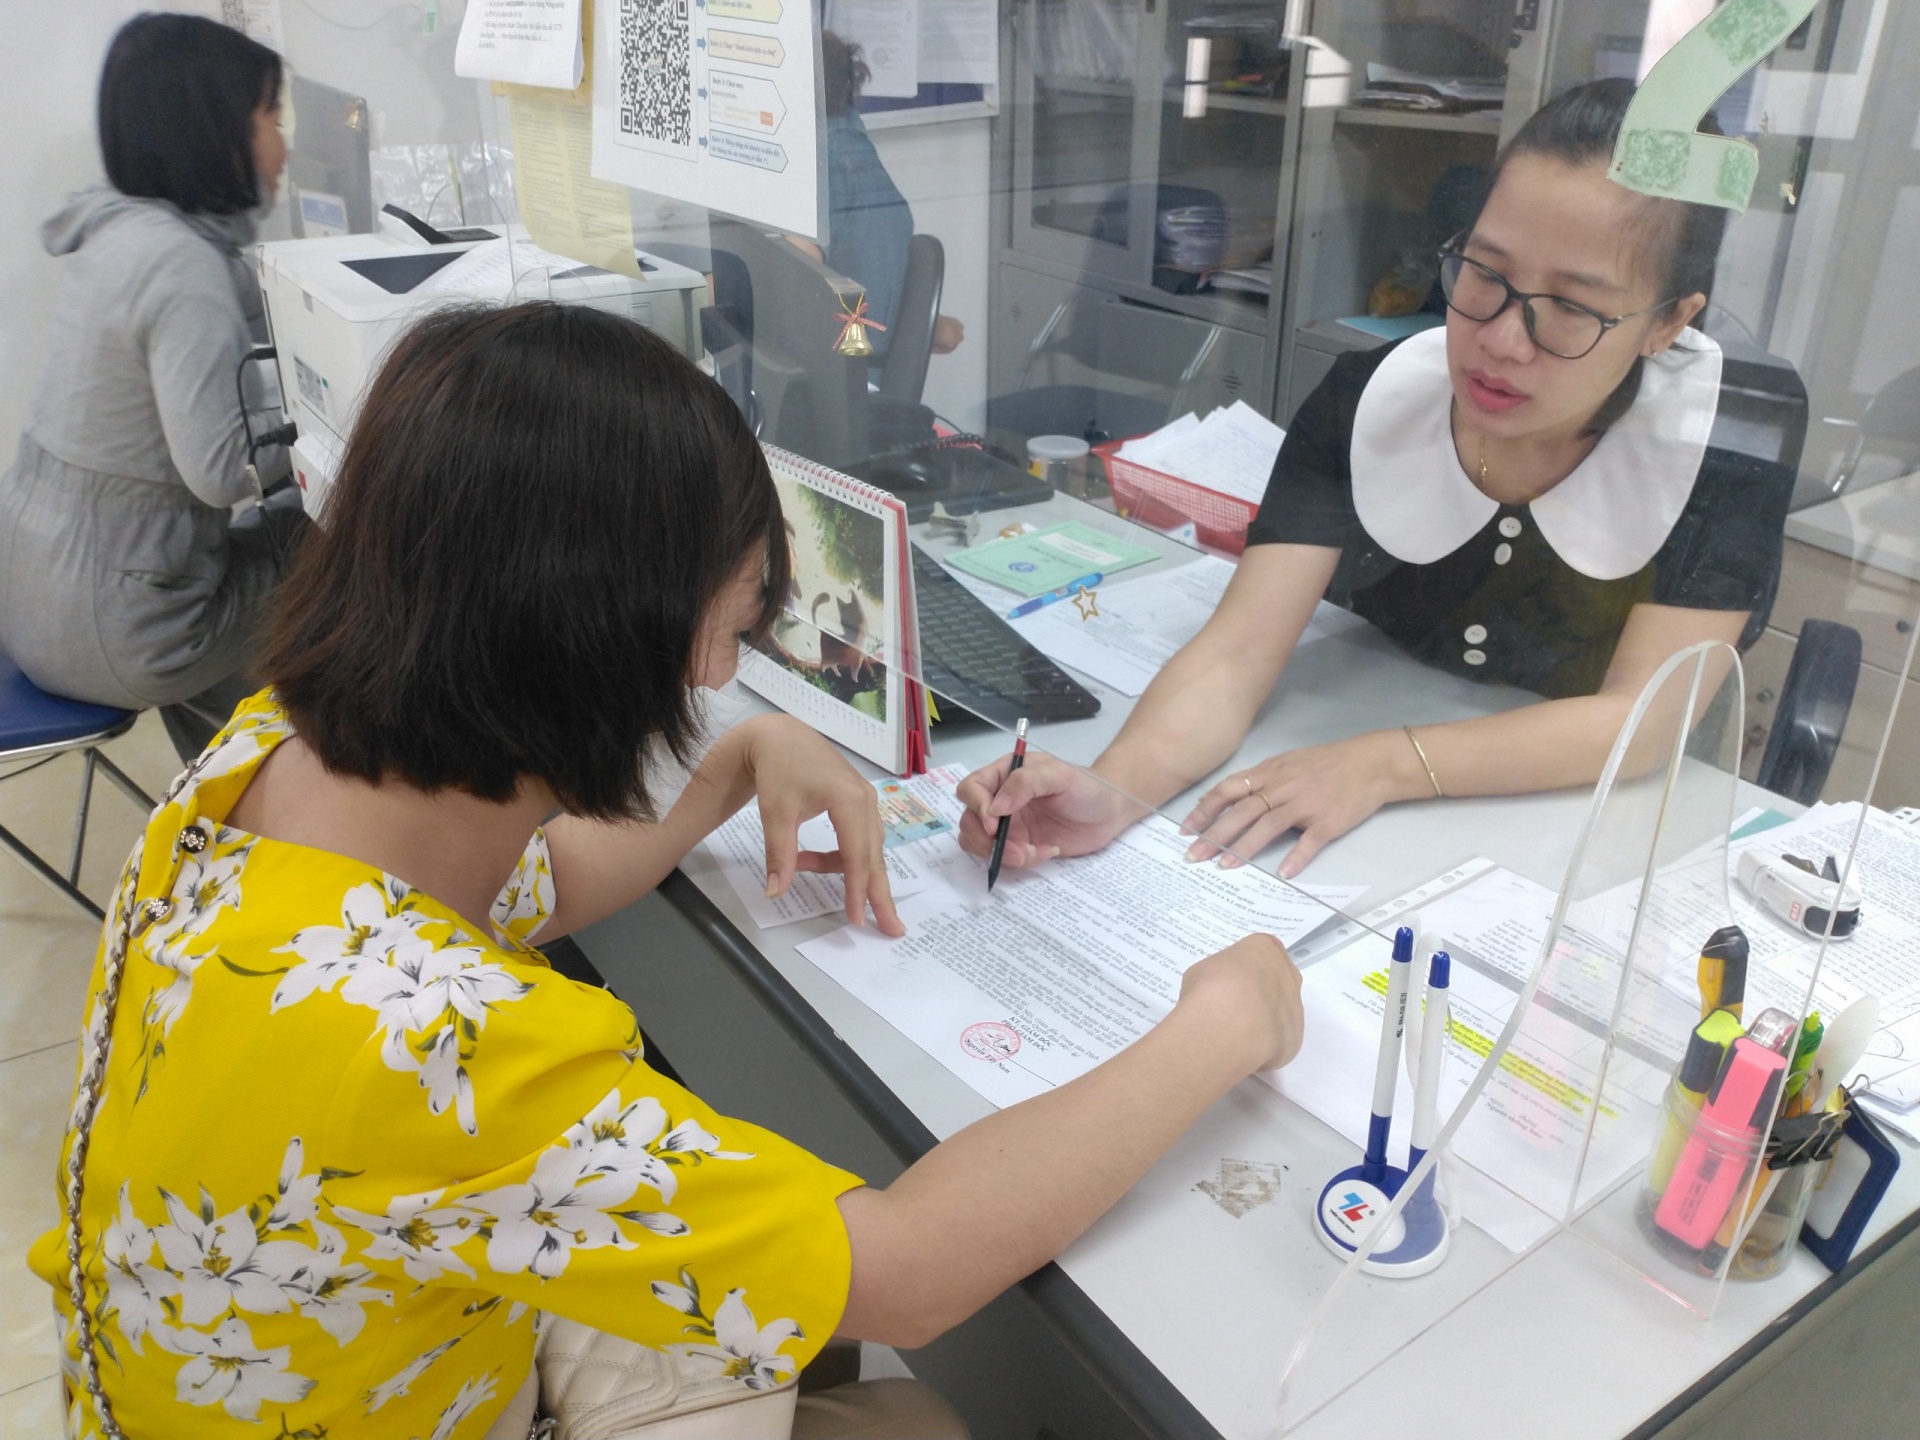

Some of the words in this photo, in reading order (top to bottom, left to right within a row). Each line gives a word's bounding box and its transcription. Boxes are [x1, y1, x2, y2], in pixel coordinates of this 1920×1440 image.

[1016, 1029, 1033, 1043] GIÁM
[1033, 1041, 1049, 1052] ĐỐC
[1021, 1024, 1039, 1038] GIÁM
[1039, 1036, 1054, 1048] ĐỐC
[964, 1038, 985, 1055] Nguyễn
[997, 1062, 1010, 1074] Nam
